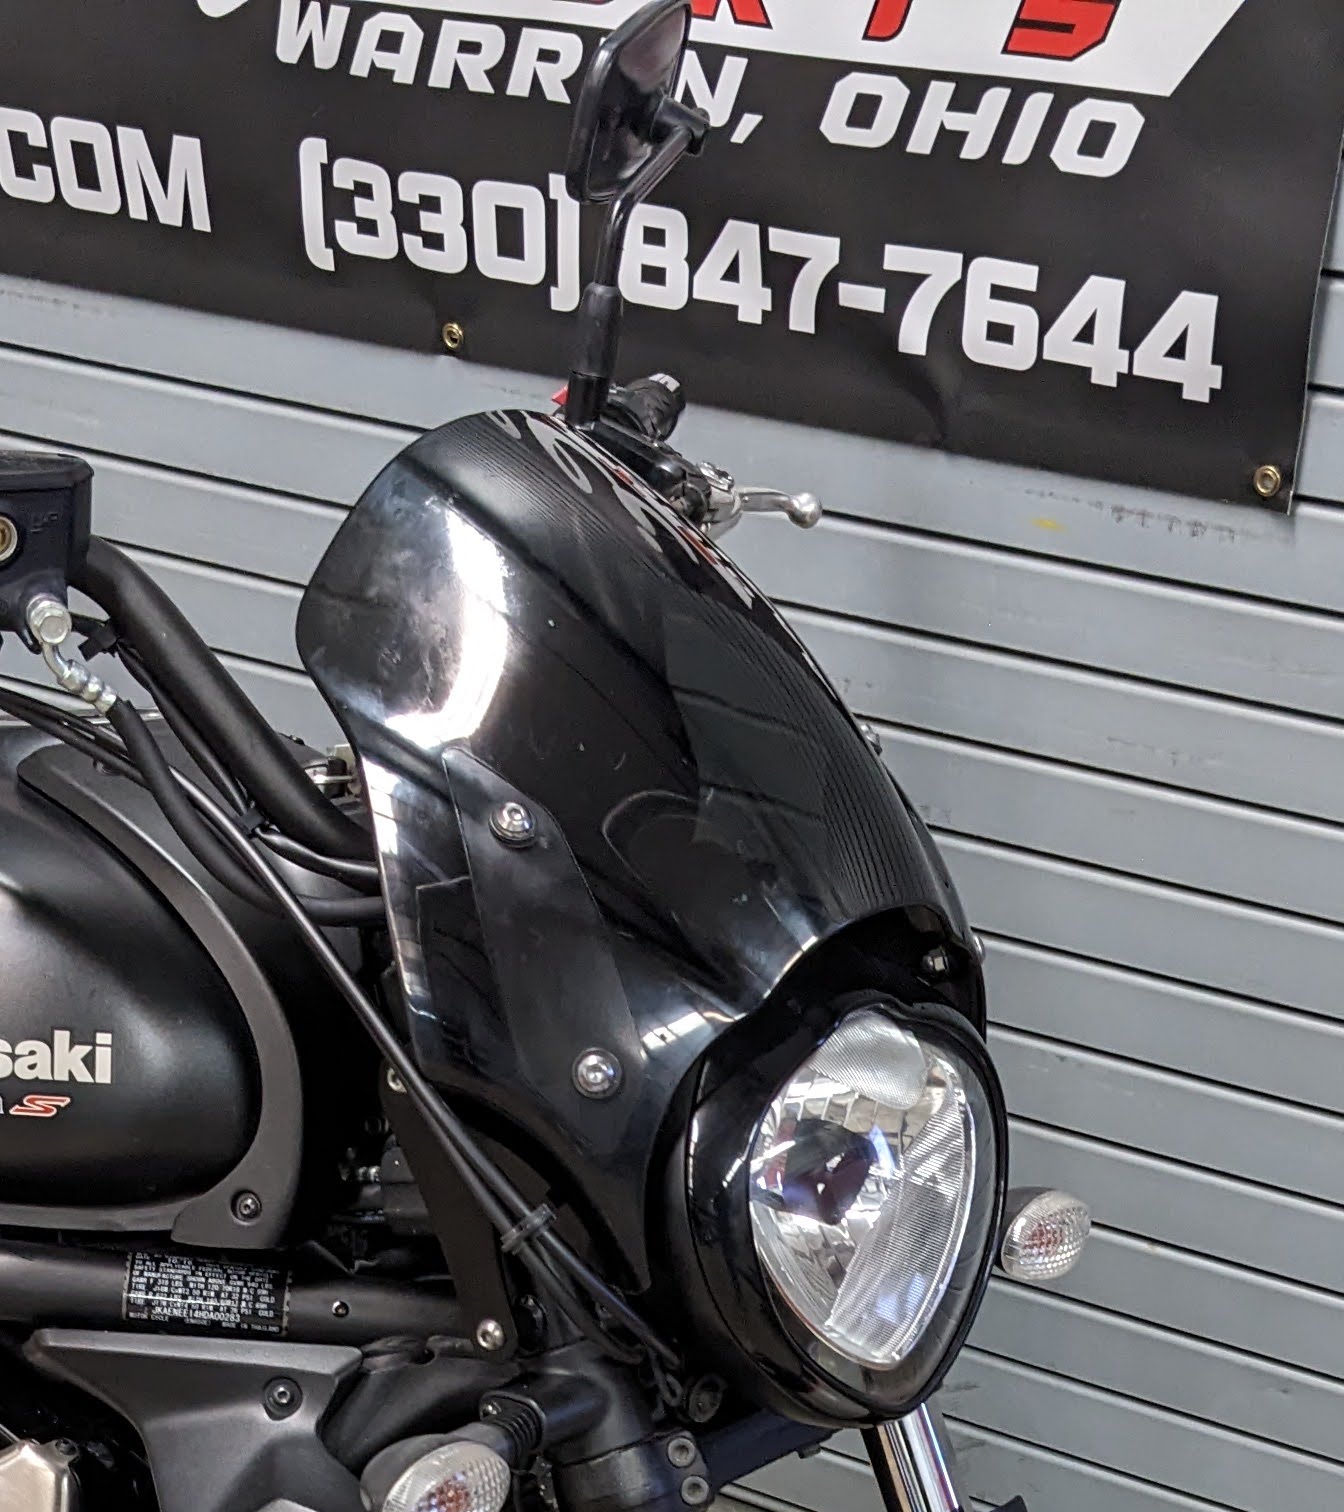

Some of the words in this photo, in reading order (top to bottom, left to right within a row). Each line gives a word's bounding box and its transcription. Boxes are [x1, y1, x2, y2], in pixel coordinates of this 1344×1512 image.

[276, 0, 764, 144] WARRN,
[818, 70, 1146, 177] OHIO
[298, 136, 581, 312] (330)
[618, 202, 1222, 403] 847-7644
[9, 1094, 71, 1118] S
